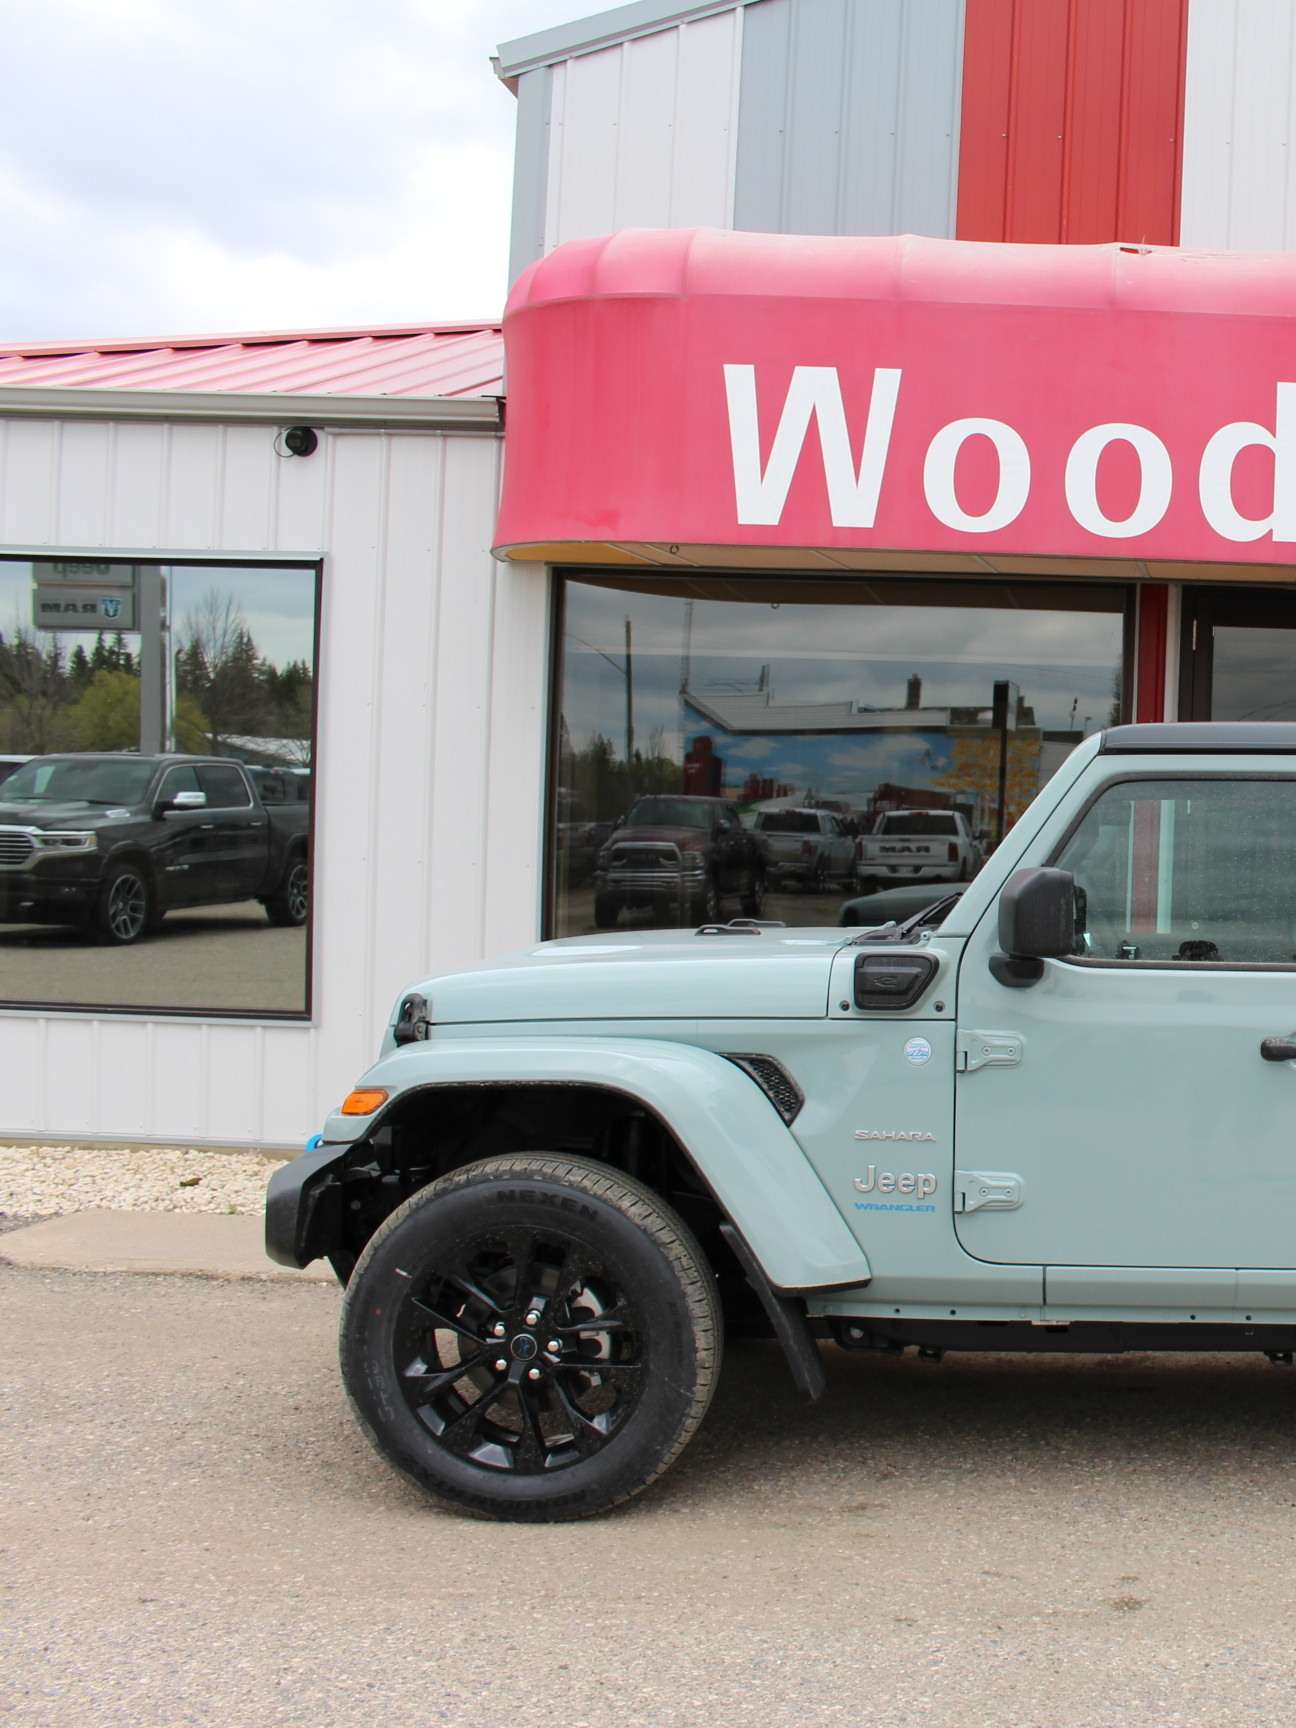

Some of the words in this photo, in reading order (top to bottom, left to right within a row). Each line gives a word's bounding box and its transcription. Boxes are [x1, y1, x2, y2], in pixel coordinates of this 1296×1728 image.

[854, 1129, 937, 1142] SAHARA
[853, 1164, 938, 1199] Jeep
[497, 1189, 599, 1220] NEXEN
[854, 1202, 936, 1213] WRANGLER
